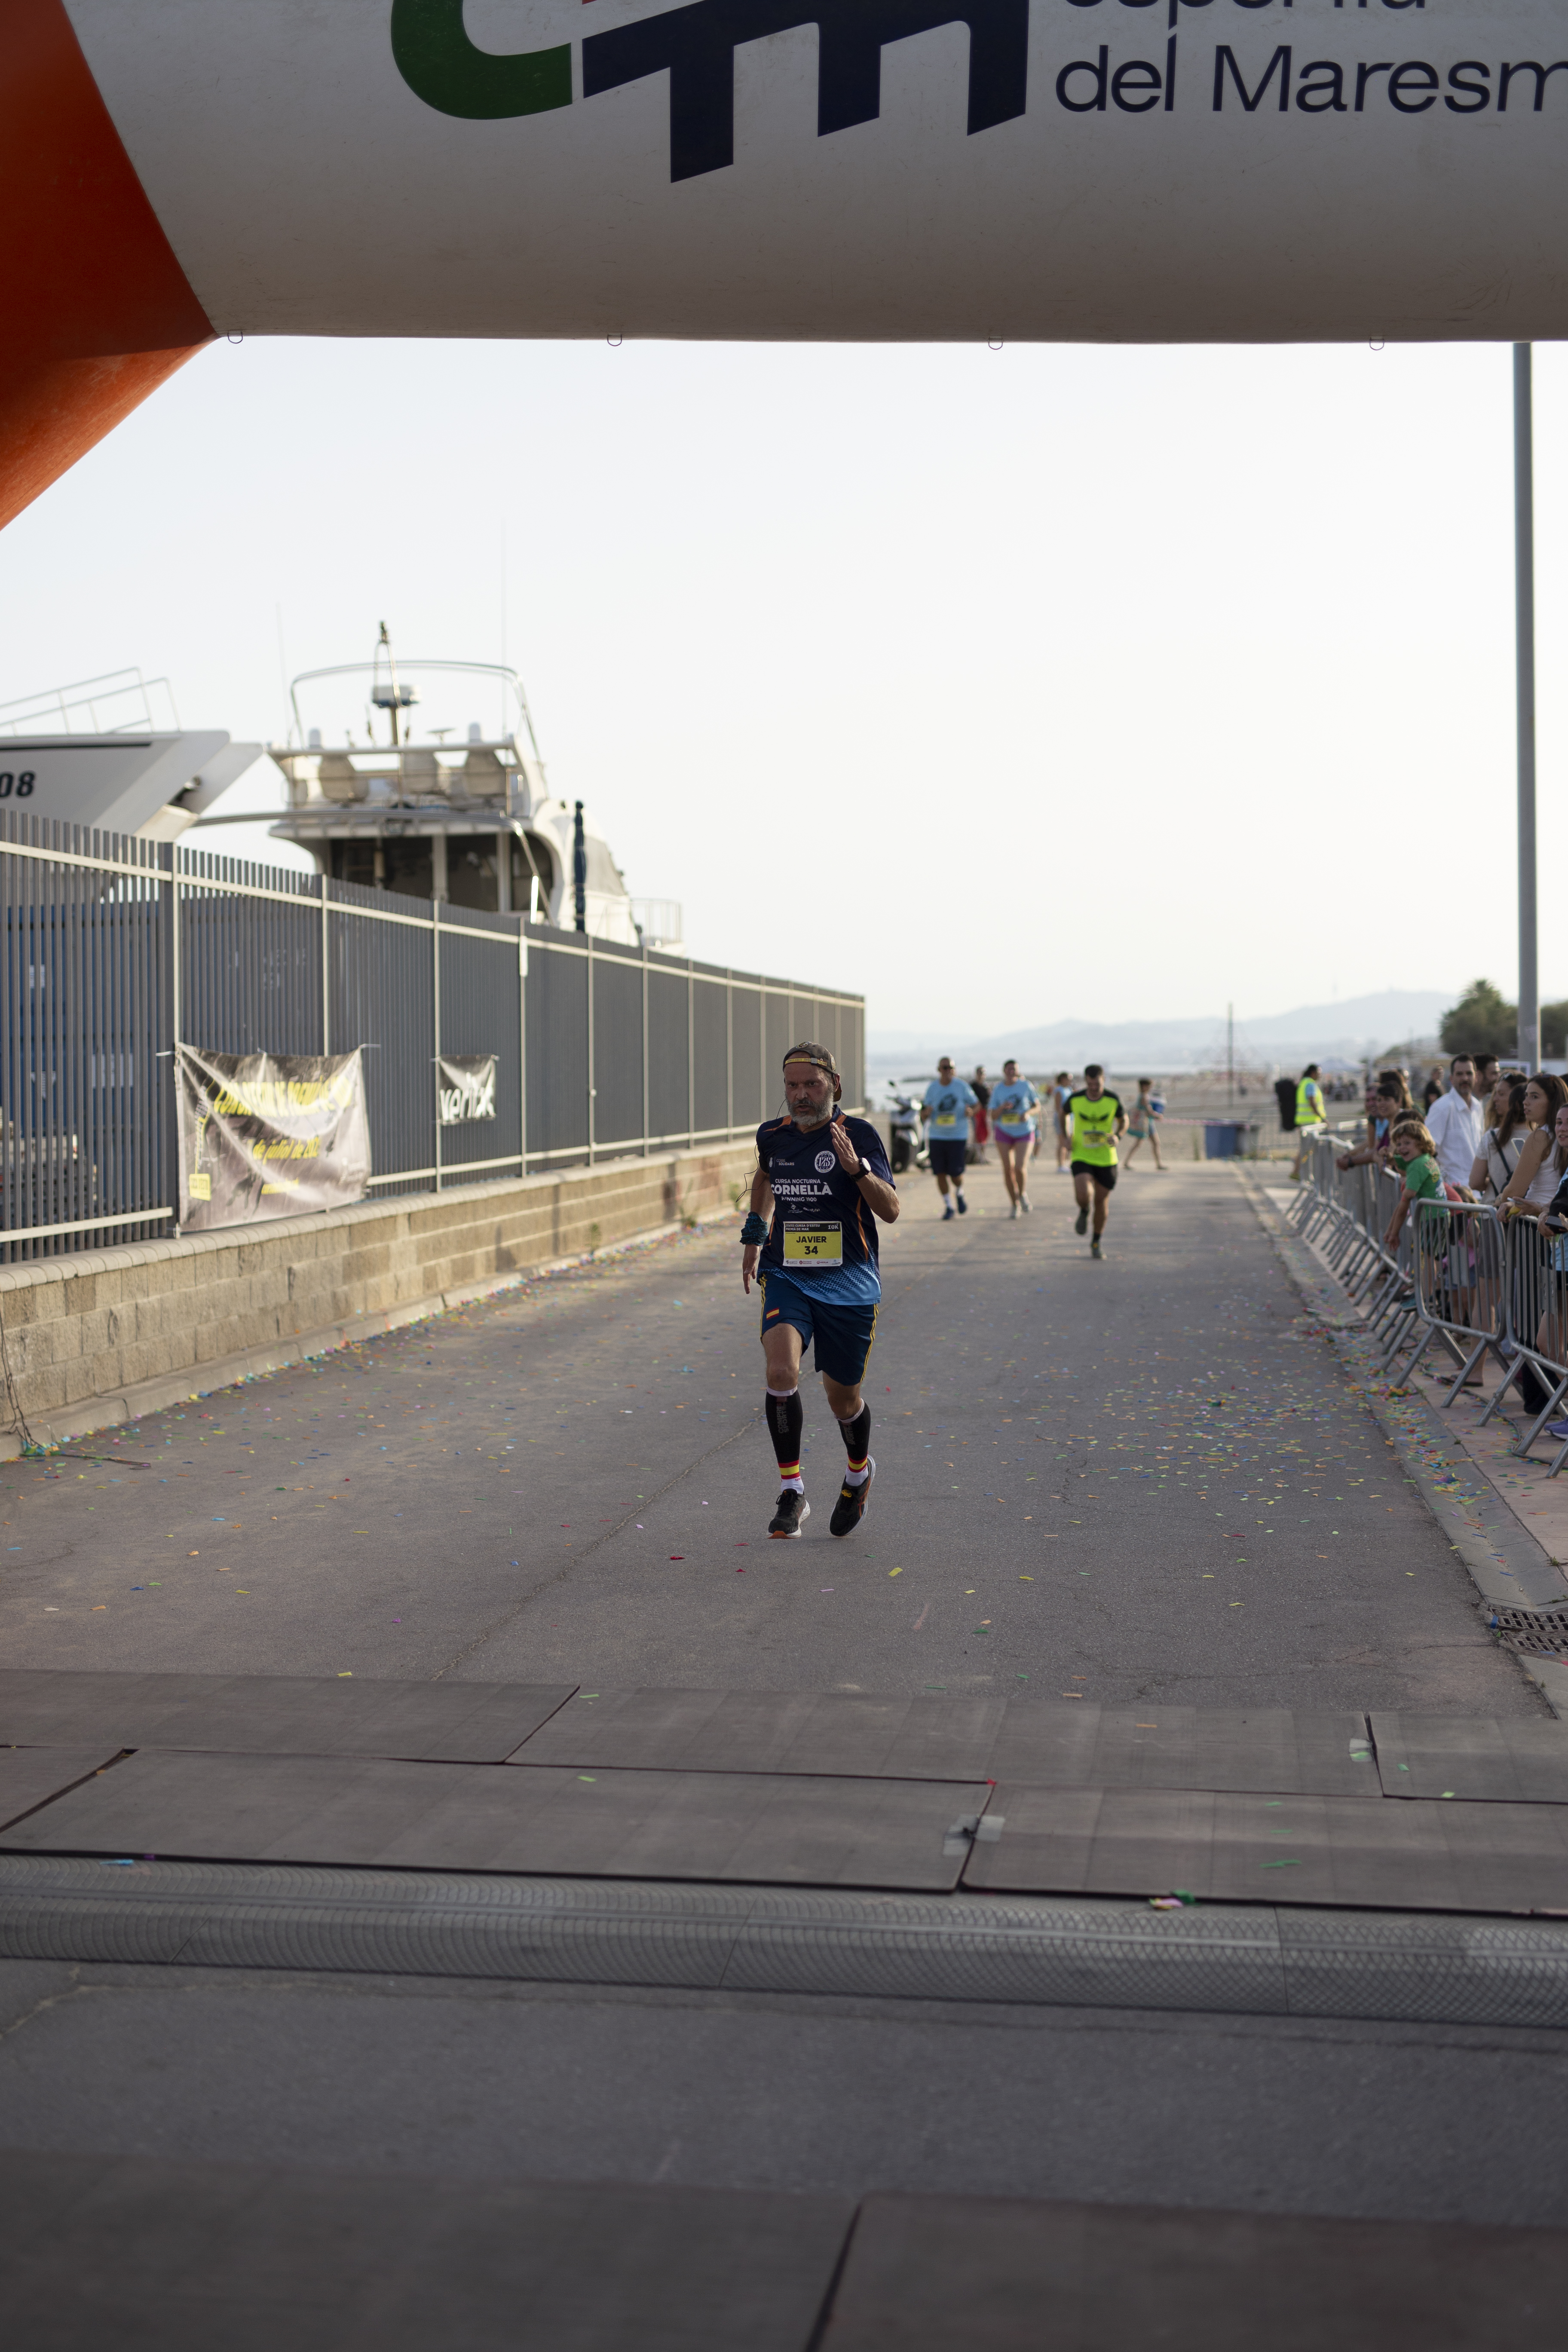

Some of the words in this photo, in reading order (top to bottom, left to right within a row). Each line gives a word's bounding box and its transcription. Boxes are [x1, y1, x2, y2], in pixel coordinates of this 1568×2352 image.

[1055, 33, 1177, 113] del
[1212, 44, 1568, 113] Maresm
[0, 771, 35, 798] 08
[303, 1136, 322, 1158] 202
[771, 1182, 832, 1195] CORNELLÀ
[804, 1246, 818, 1255] 34
